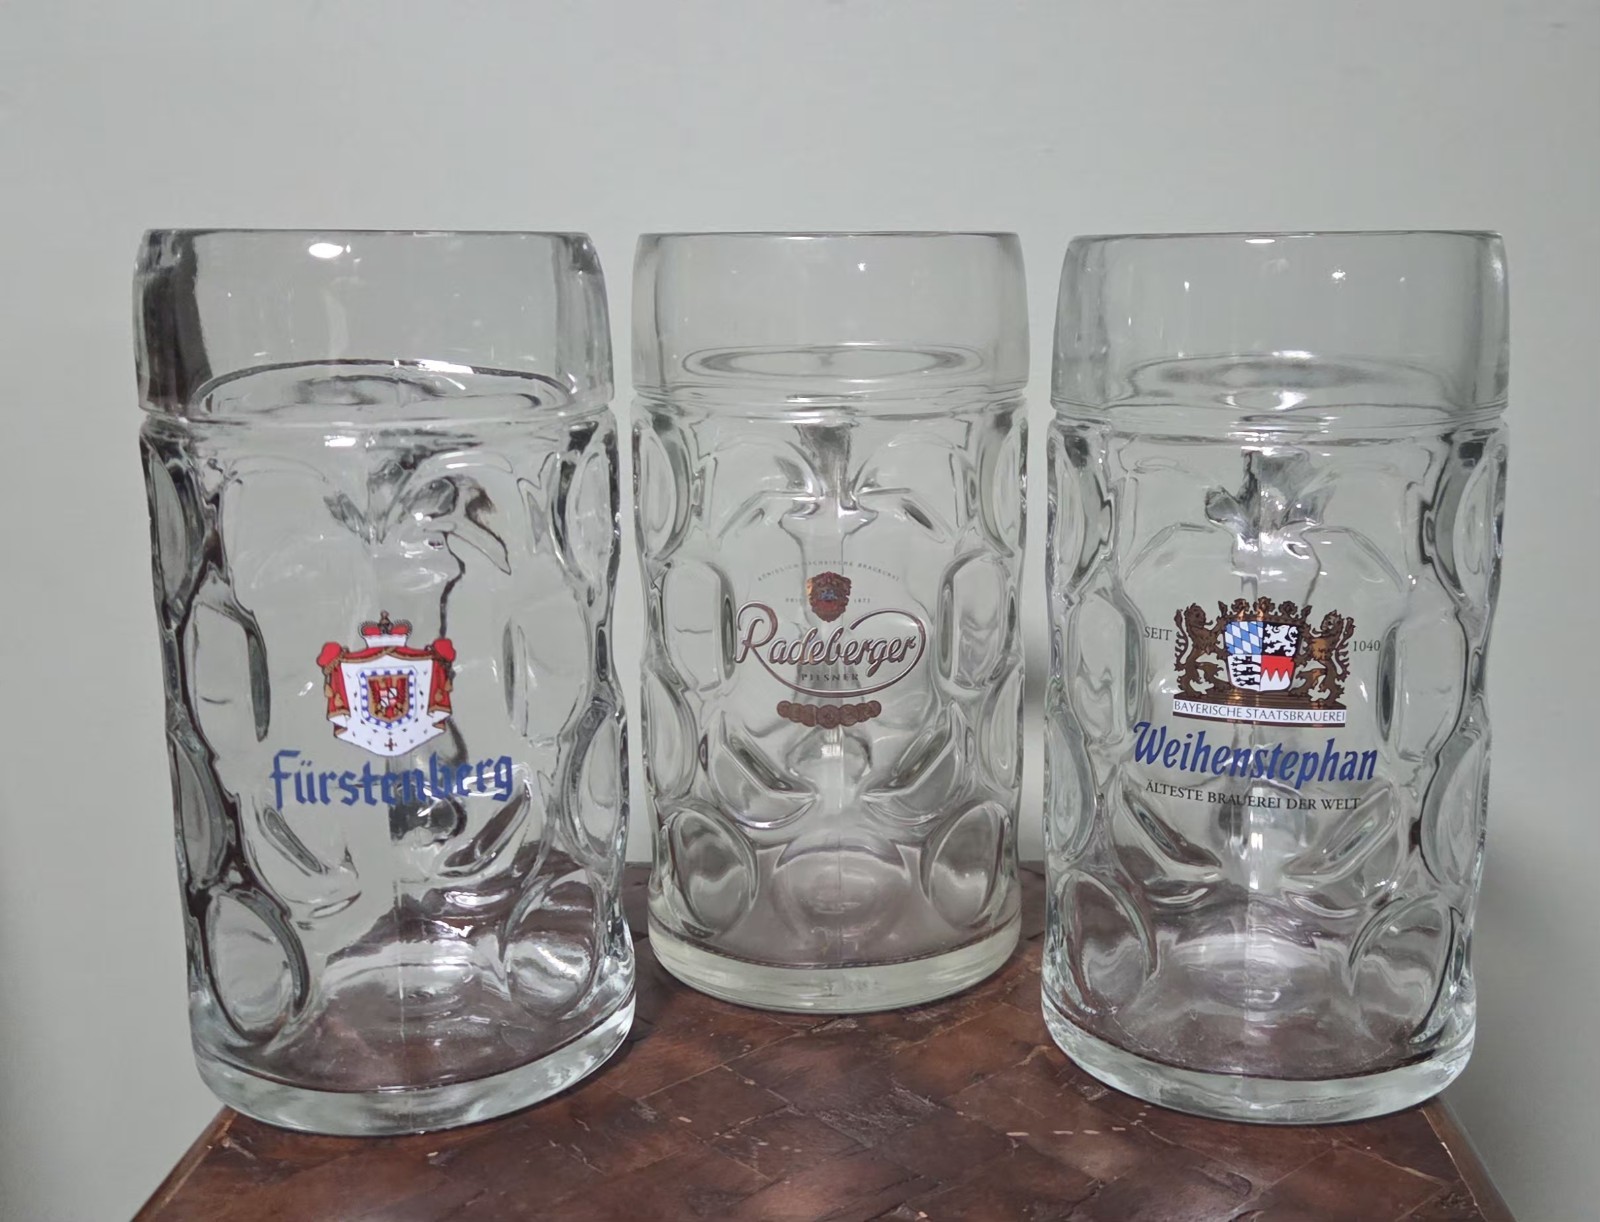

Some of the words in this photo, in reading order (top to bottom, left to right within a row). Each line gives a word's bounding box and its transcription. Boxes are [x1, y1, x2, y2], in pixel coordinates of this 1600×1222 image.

[734, 601, 920, 680] Radeberger
[1143, 626, 1173, 641] SEIT
[1352, 639, 1381, 652] 1040
[801, 673, 860, 681] PILSNER
[1173, 701, 1243, 718] BAYERISCHE
[1245, 708, 1346, 722] STAATSBRAUEREI
[1133, 721, 1378, 789] Weihenstephan
[269, 749, 513, 812] Fürstenberg
[1145, 779, 1204, 801] ÄLTESTE
[1207, 791, 1281, 809] BRAUEREI
[1286, 797, 1317, 810] DER
[1320, 797, 1361, 810] WELT
